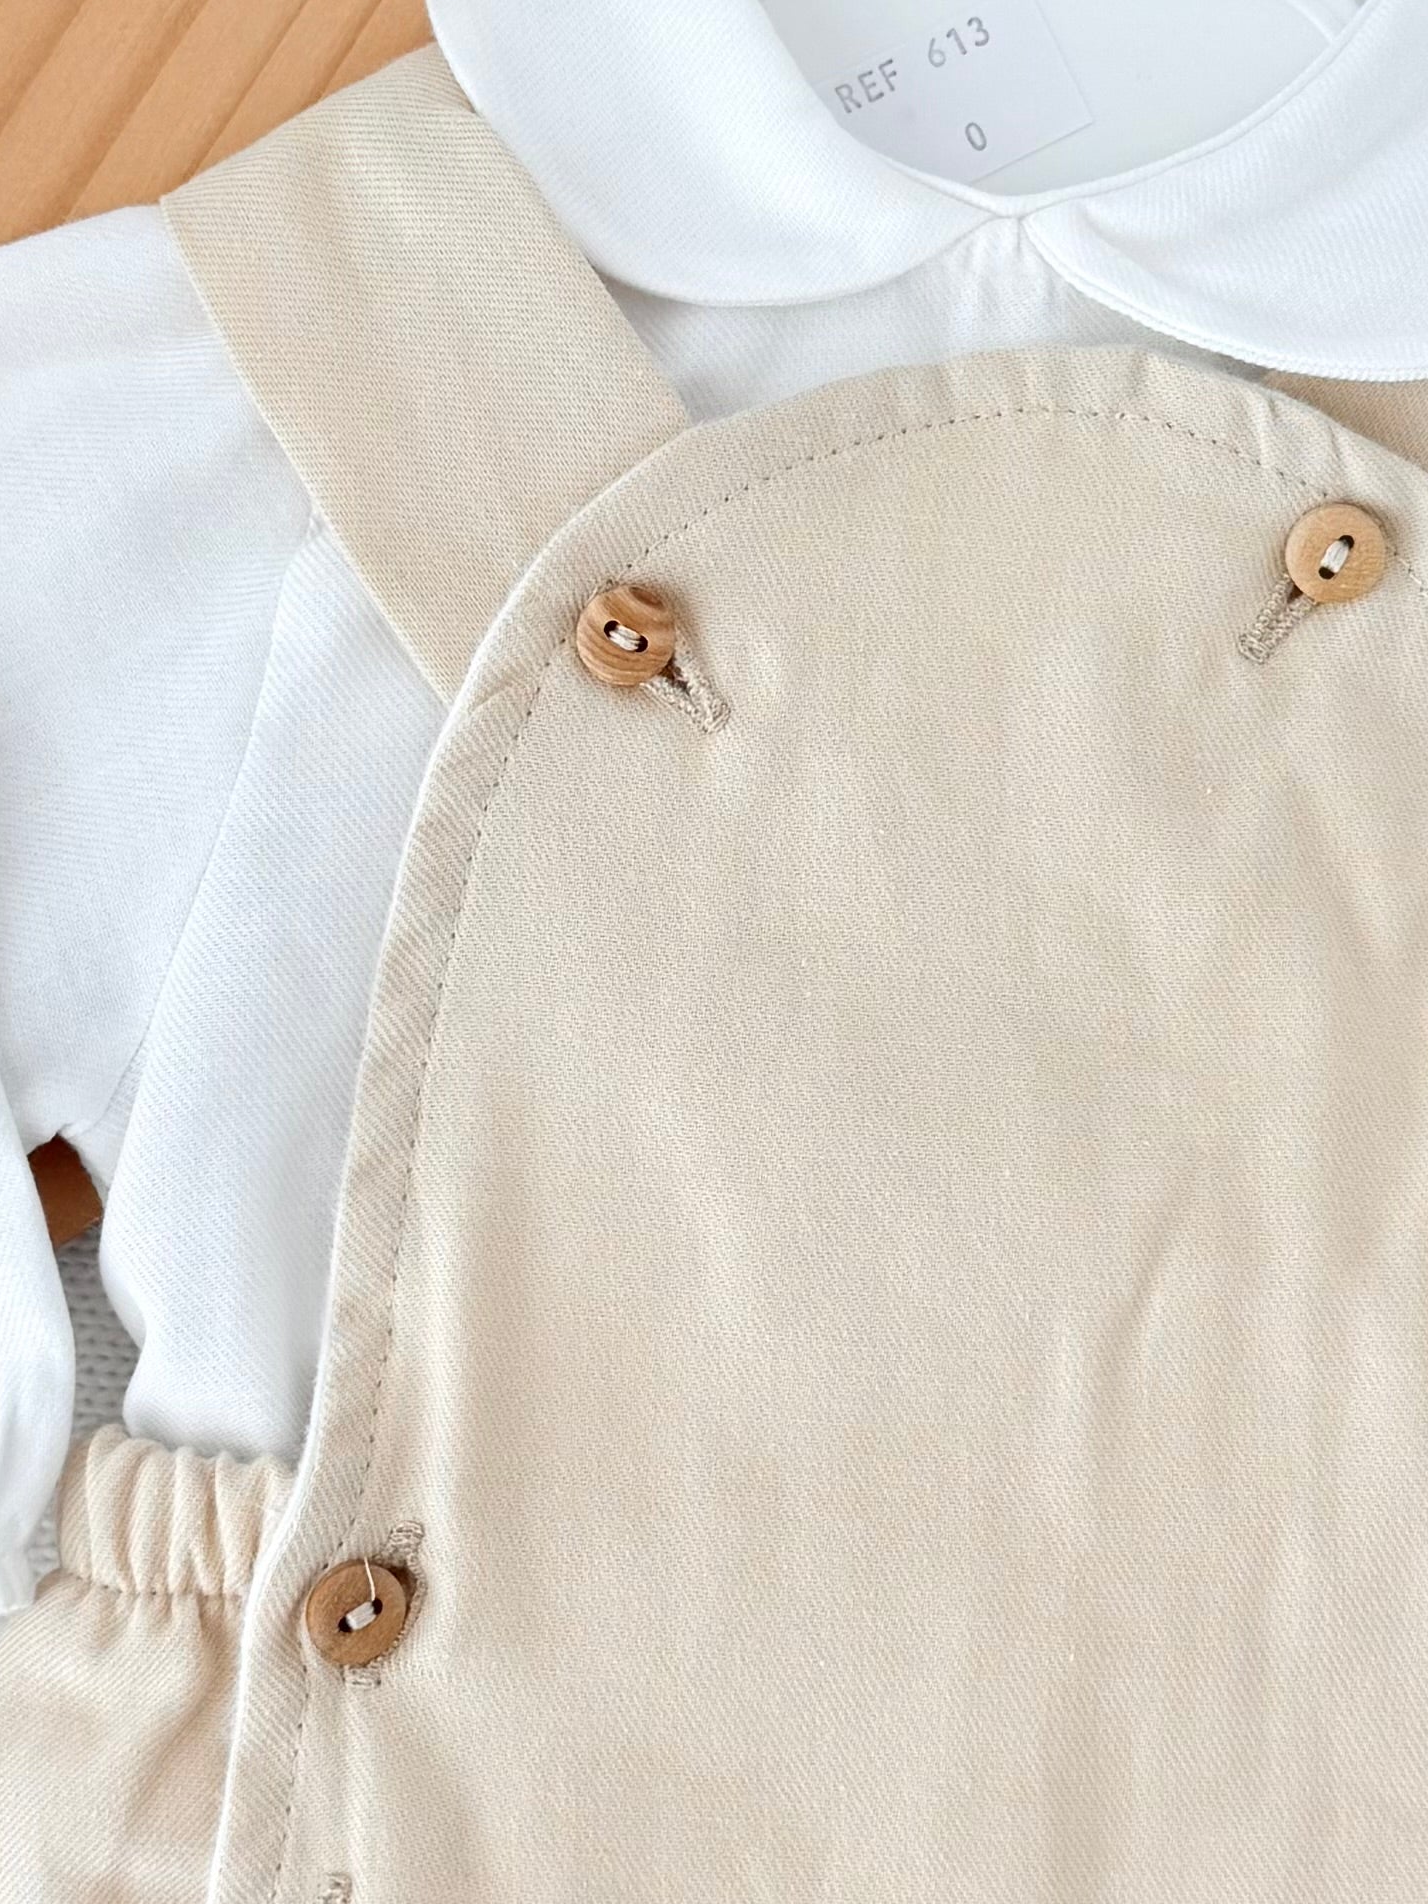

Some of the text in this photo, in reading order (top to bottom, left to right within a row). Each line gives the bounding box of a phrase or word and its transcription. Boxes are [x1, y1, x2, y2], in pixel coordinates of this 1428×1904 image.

[834, 16, 991, 114] REF 613
[964, 122, 988, 152] 0
